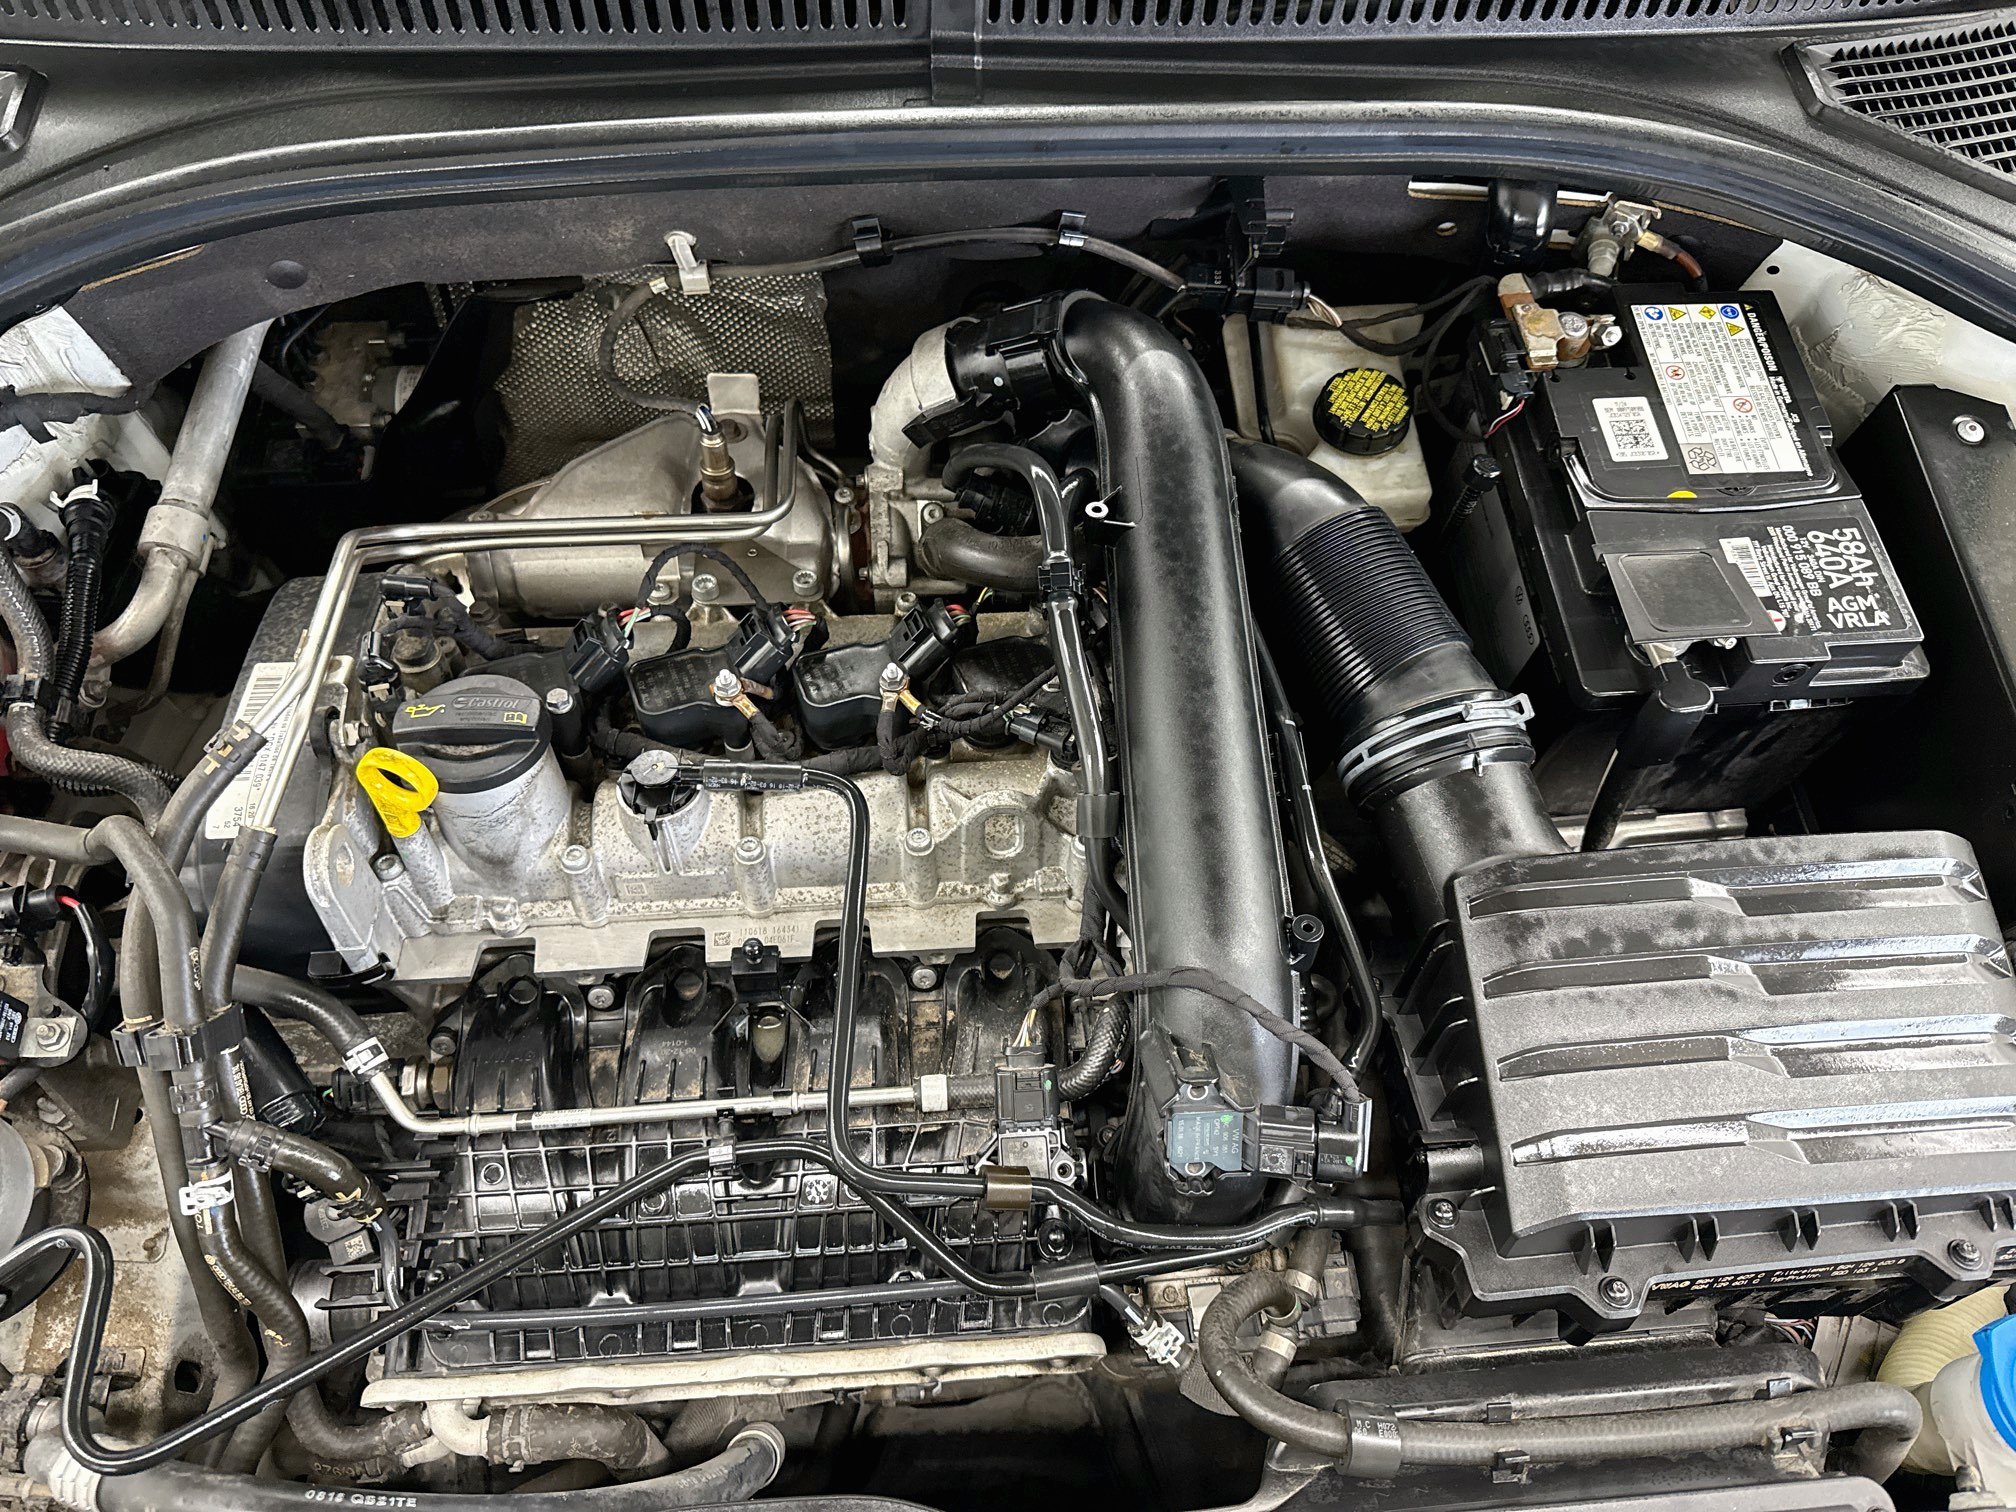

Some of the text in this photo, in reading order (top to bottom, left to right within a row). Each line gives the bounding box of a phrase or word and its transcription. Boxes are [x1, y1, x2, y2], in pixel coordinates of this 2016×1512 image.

[1746, 312, 1778, 371] DANGER/POISON
[1780, 525, 1823, 596] 000 915 089 BB
[1806, 530, 1855, 589] 640A
[1829, 527, 1875, 586] 58Ah
[1828, 594, 1878, 613] AGM
[1826, 611, 1891, 629] VRLA
[468, 697, 521, 709] Castrol
[258, 754, 270, 771] 0147
[232, 806, 243, 827] 3754
[1231, 1128, 1240, 1154] VW AG
